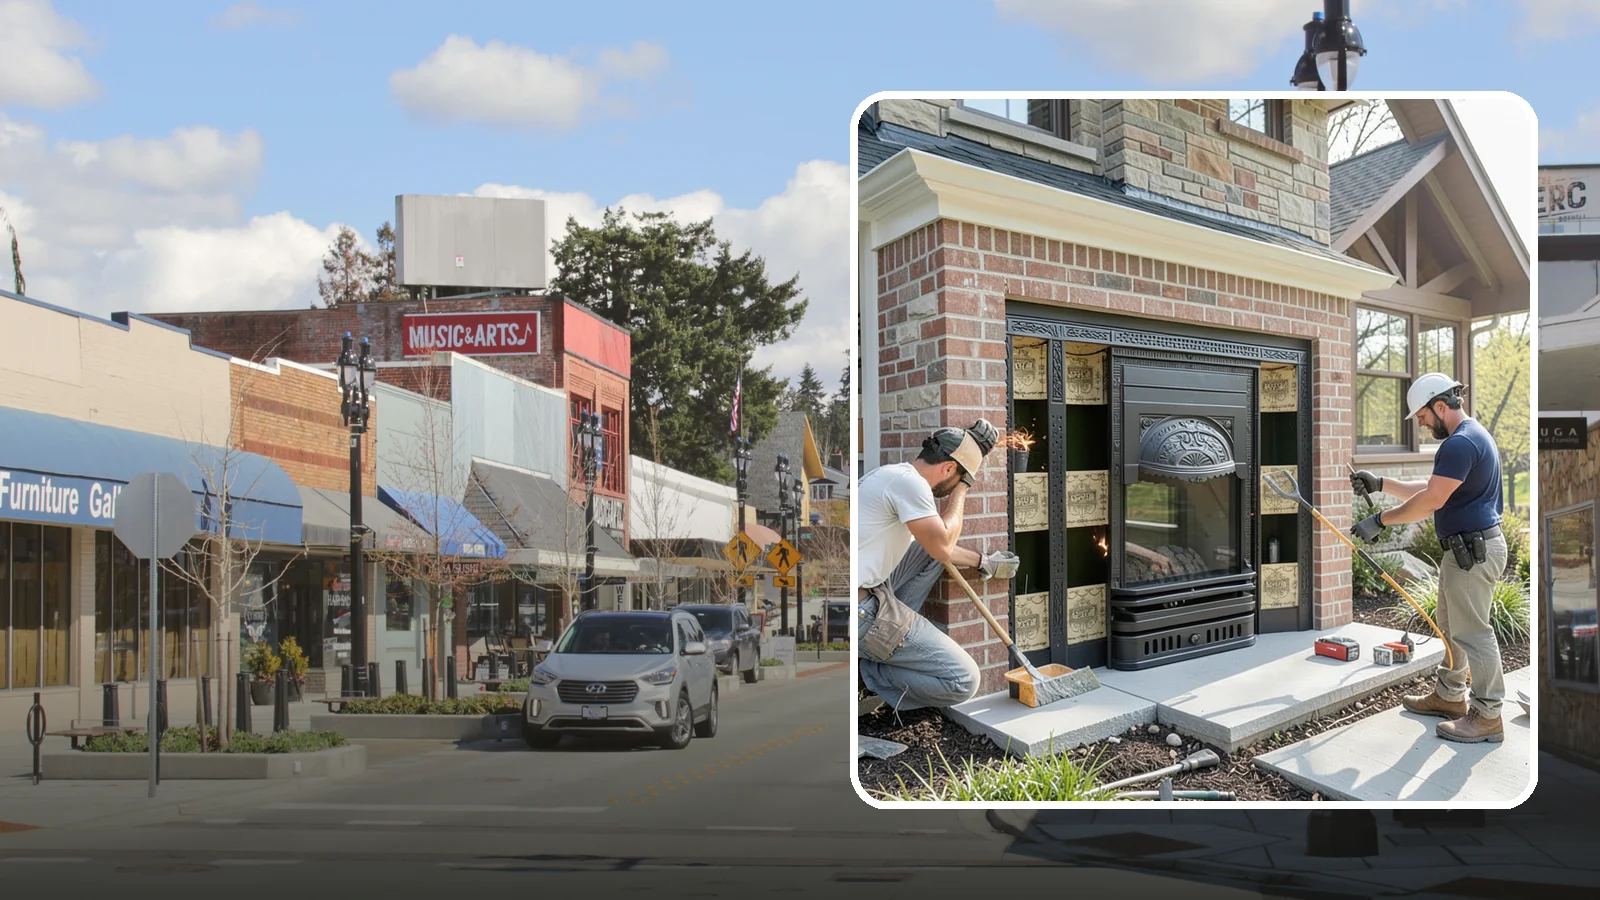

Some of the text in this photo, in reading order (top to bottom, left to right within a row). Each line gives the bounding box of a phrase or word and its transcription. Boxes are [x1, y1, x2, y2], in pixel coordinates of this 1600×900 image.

[0, 471, 122, 519] Furniture Gal
[453, 563, 479, 574] SUSHI
